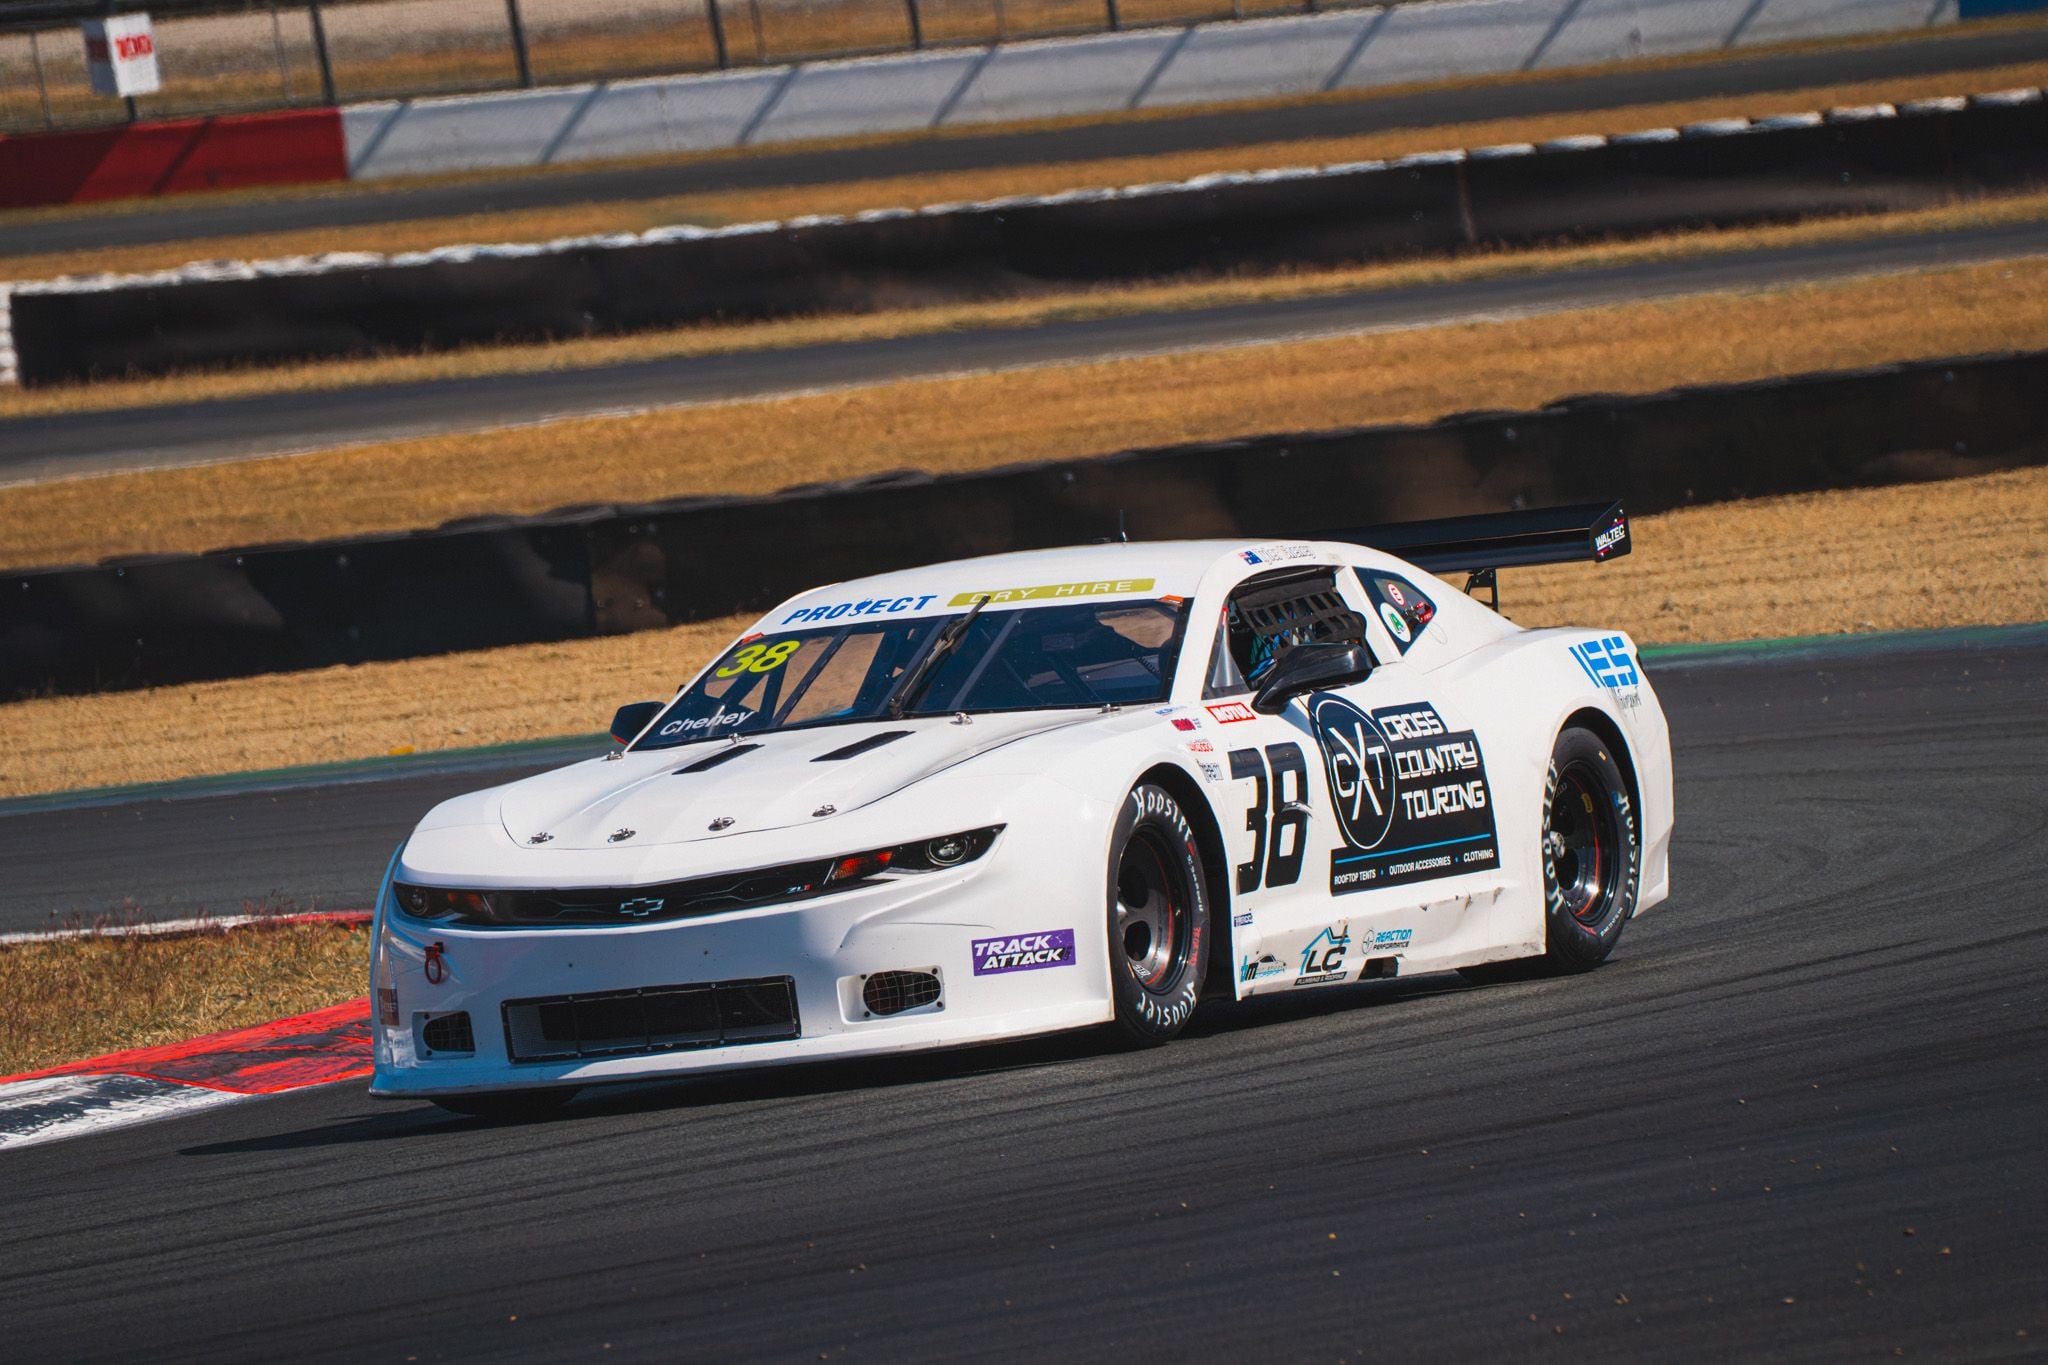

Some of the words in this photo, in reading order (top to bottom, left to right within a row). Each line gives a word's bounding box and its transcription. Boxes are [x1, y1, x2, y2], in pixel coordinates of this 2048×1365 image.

[1594, 524, 1625, 547] WALTEC
[969, 588, 1037, 604] DRY
[1056, 580, 1133, 597] HIRE
[716, 640, 800, 678] 38
[660, 711, 754, 735] Cheney
[1210, 703, 1252, 722] MOTUL
[1378, 710, 1444, 742] CROSS
[1394, 741, 1478, 779] COUNTRY
[1401, 780, 1486, 821] TOURING
[1228, 741, 1309, 896] 38
[1334, 872, 1359, 885] ROOFTOP
[1360, 869, 1376, 881] TENTS
[1389, 862, 1415, 876] OUTDOOR
[1415, 856, 1451, 871] ACCESSORIES
[1463, 849, 1494, 863] CLOTHING
[974, 935, 1053, 957] TRACK
[1376, 929, 1412, 942] REACTION
[982, 948, 1064, 970] ATTACK
[1306, 947, 1346, 973] LC
